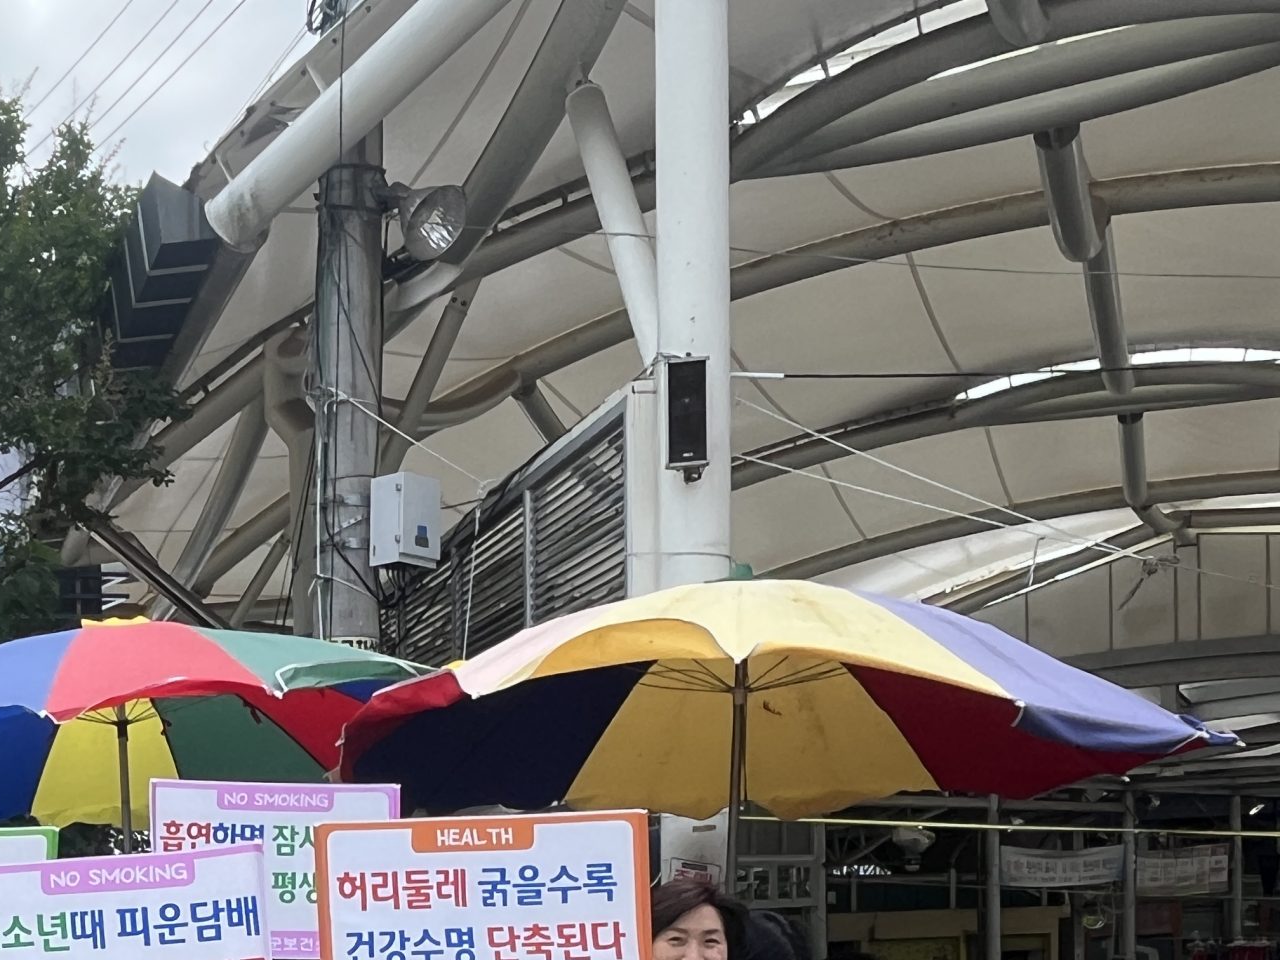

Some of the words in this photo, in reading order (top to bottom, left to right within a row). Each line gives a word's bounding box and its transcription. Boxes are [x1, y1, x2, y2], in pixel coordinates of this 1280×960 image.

[223, 791, 248, 806] NO
[253, 792, 329, 808] SMOKING
[436, 827, 513, 848] HEALTH
[49, 870, 81, 889] NO
[88, 862, 188, 886] SMOKING
[336, 867, 468, 912] 허리둘레
[477, 862, 617, 908] 굵을수록
[115, 895, 261, 947] 피운담배
